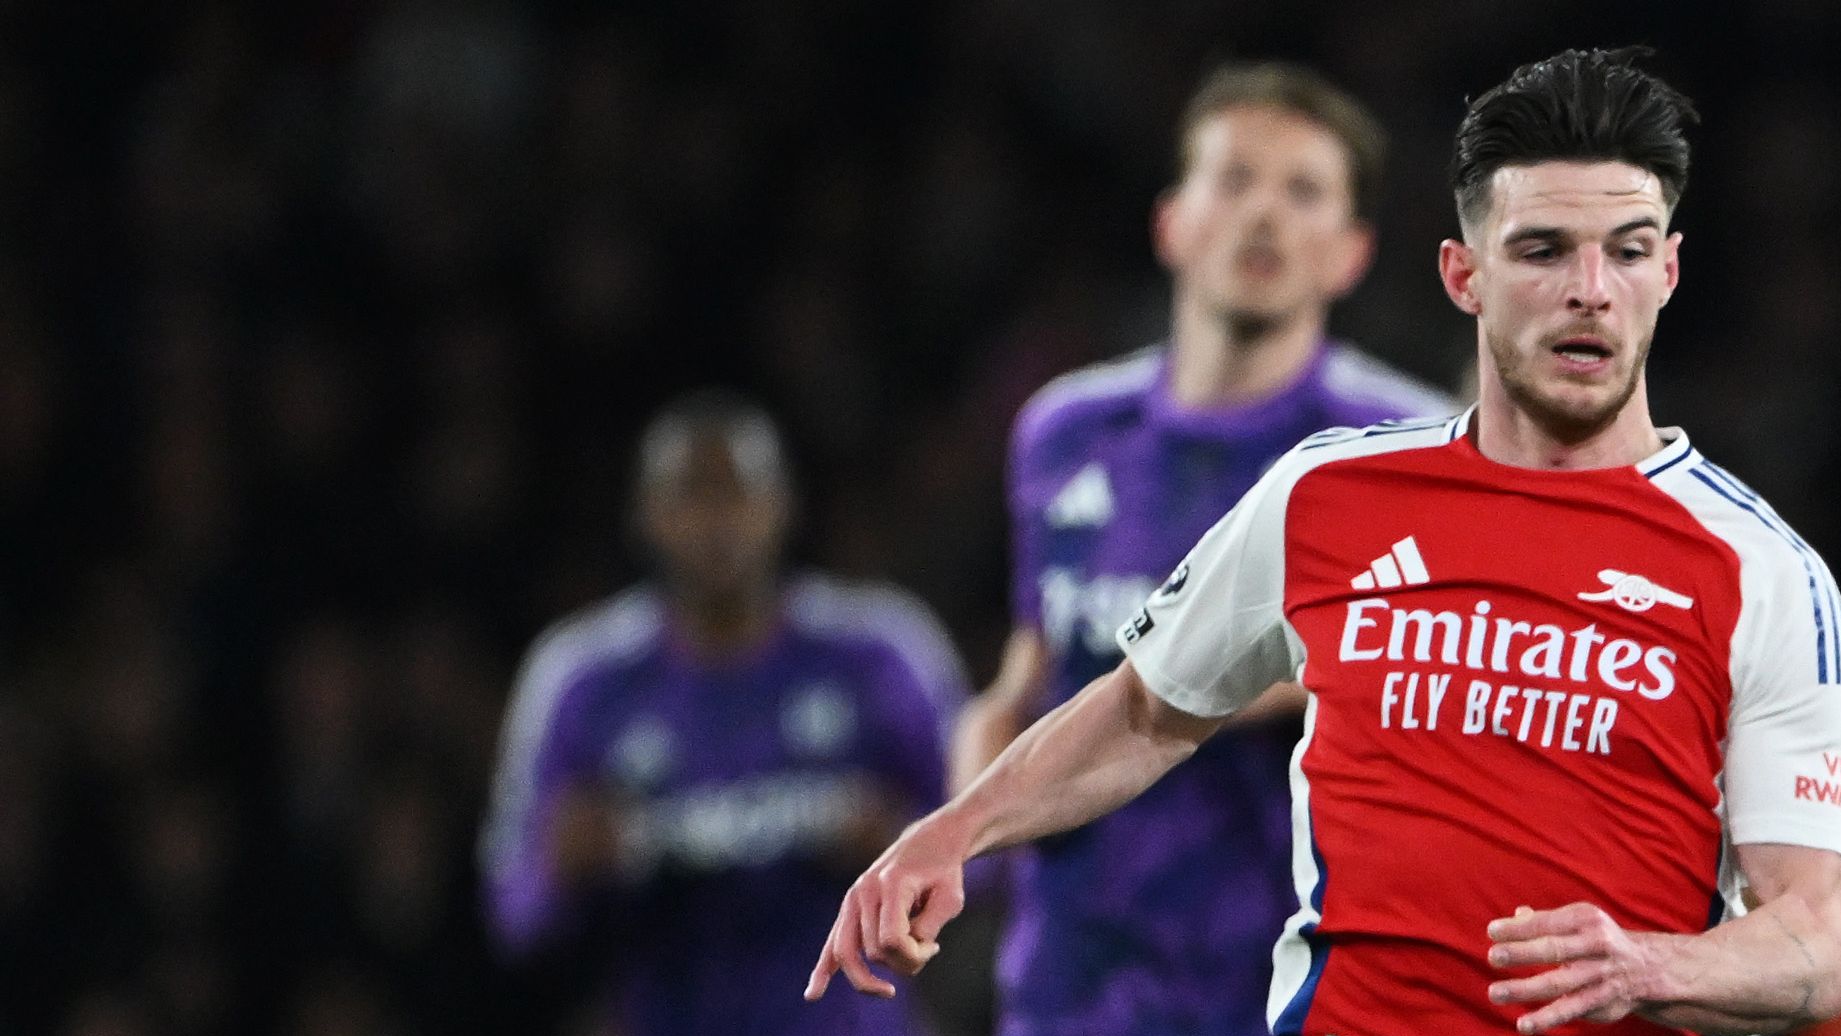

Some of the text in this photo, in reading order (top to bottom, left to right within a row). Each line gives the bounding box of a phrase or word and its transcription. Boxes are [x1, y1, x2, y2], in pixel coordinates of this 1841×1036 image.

[1339, 598, 1677, 700] Emirates
[1380, 672, 1619, 756] FLY BETTER
